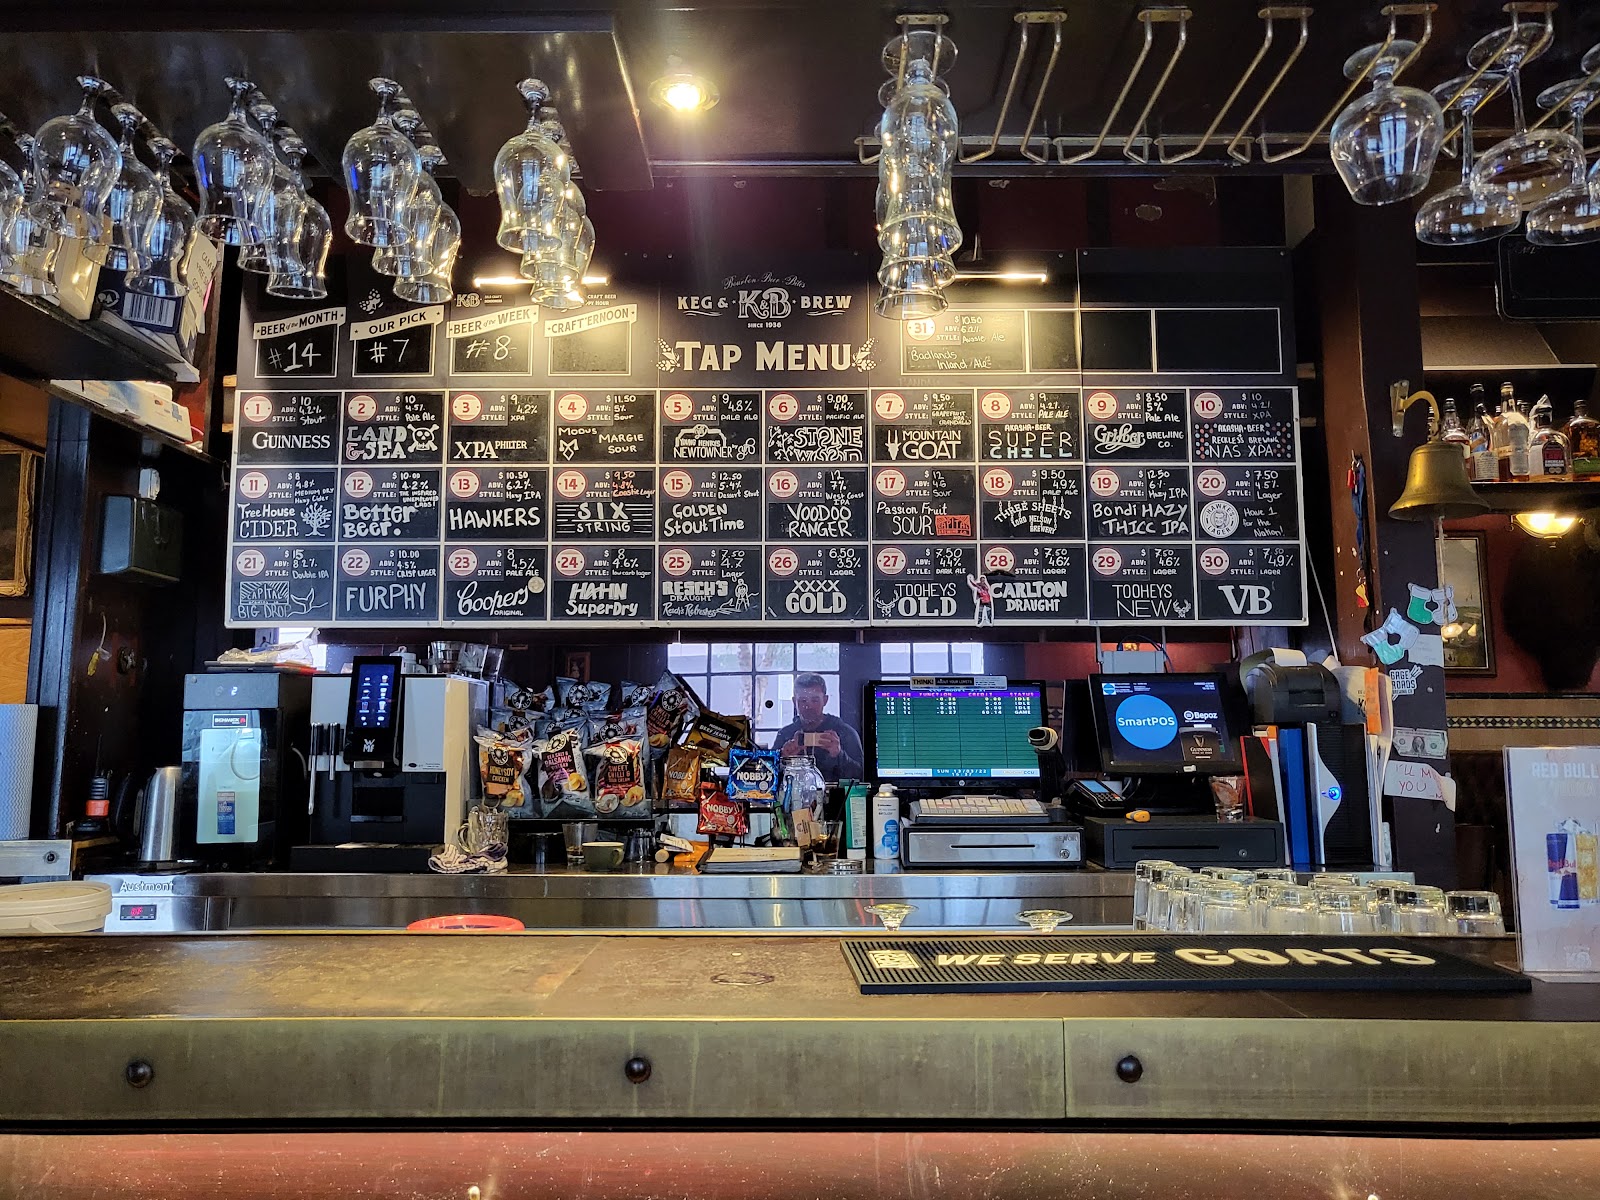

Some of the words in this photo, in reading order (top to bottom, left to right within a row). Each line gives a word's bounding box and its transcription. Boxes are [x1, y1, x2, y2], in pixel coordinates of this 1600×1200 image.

[678, 296, 712, 309] KEG
[718, 297, 728, 309] &
[801, 296, 852, 309] BREW
[260, 321, 285, 335] BEER
[299, 310, 338, 327] MONTH
[369, 321, 395, 335] OUR
[400, 312, 427, 326] PICK
[453, 321, 482, 334] BEER
[498, 309, 531, 325] WEEK
[914, 323, 927, 334] 31
[911, 350, 957, 361] Badlands
[405, 395, 416, 404] 10
[827, 394, 848, 404] 9.00
[1146, 393, 1168, 402] 8.50
[255, 403, 260, 415] 1
[358, 403, 366, 414] 2
[463, 403, 470, 413] 3
[568, 402, 577, 413] 4
[674, 402, 682, 413] 5
[778, 402, 788, 413] 6
[885, 401, 893, 412] 7
[991, 400, 1001, 411] 8
[1098, 400, 1107, 411] 9
[1200, 400, 1216, 411] 10
[1145, 412, 1162, 423] Pale
[1165, 413, 1180, 423] Ale
[347, 425, 407, 442] LAND
[599, 434, 644, 444] MARGIE
[794, 426, 864, 448] STONE
[902, 430, 961, 441] MOUNTAIN
[988, 430, 1074, 448] SUPER
[1147, 431, 1184, 439] BREWING
[252, 432, 330, 450] GUINNESS
[454, 441, 498, 459] XPA
[495, 441, 528, 450] PHILTER
[674, 446, 733, 459] NEWTOWNER
[902, 441, 962, 460] GOAT
[990, 447, 1073, 459] CHILL
[1209, 445, 1242, 459] NAS
[1248, 445, 1274, 457] XPA
[507, 471, 529, 480] 10.50
[719, 472, 742, 481] 12.50
[1041, 470, 1066, 480] 9.50
[1254, 470, 1279, 479] 7.50
[249, 480, 259, 491] 11
[352, 479, 364, 491] 12
[458, 478, 470, 490] 13
[564, 478, 578, 490] 14
[671, 478, 684, 490] 15
[776, 478, 791, 490] 16
[884, 477, 896, 489] 17
[990, 476, 1005, 488] 18
[1098, 477, 1112, 489] 19
[1202, 477, 1221, 489] 20
[524, 491, 542, 500] IPA
[1257, 491, 1283, 503] Lager
[343, 504, 419, 524] Better
[578, 502, 629, 520] SIX
[673, 504, 727, 520] GOLDEN
[787, 503, 852, 521] VOODOO
[876, 502, 919, 516] Passion
[921, 502, 948, 516] Fruit
[994, 502, 1029, 523] THREE
[1031, 502, 1072, 520] SHEETS
[1093, 502, 1137, 518] Bondi
[1142, 503, 1188, 522] HAZY
[450, 507, 541, 530] HAWKERS
[240, 520, 299, 538] CIDER
[577, 521, 631, 533] STRING
[788, 520, 852, 538] RANGER
[892, 515, 935, 536] SOUR
[1103, 519, 1156, 536] THICC
[1162, 520, 1189, 534] IPA
[398, 550, 420, 559] 10.00
[721, 550, 745, 560] 7.50
[244, 558, 257, 569] 21
[348, 557, 363, 569] 22
[454, 557, 470, 569] 23
[561, 557, 579, 569] 24
[668, 557, 685, 569] 25
[774, 557, 791, 568] 26
[883, 555, 899, 567] 27
[990, 555, 1008, 567] 28
[1098, 556, 1115, 568] 29
[1205, 556, 1224, 568] 30
[569, 582, 628, 601] HAHN
[662, 580, 729, 596] RESCH'S
[792, 580, 840, 593] XXXX
[895, 583, 957, 597] TOOHEYS
[990, 581, 1068, 599] CARLTON
[1112, 584, 1173, 600] TOOHEYS
[346, 582, 426, 612] FURPHY
[457, 581, 529, 616] Coopers
[786, 592, 847, 614] GOLD
[1218, 585, 1273, 616] VB
[897, 597, 957, 617] OLD
[1006, 599, 1061, 612] DRAUGHT
[1117, 599, 1172, 618] NEW
[1118, 717, 1175, 726] SmartPOS
[1194, 712, 1218, 720] Bepoz
[1532, 763, 1558, 777] RED
[1564, 763, 1599, 779] BULL
[1399, 781, 1426, 794] YOU
[120, 881, 174, 892] Austmont
[936, 954, 1006, 966] WE
[1014, 952, 1157, 965] SERVE
[1175, 948, 1436, 966] GOATS
